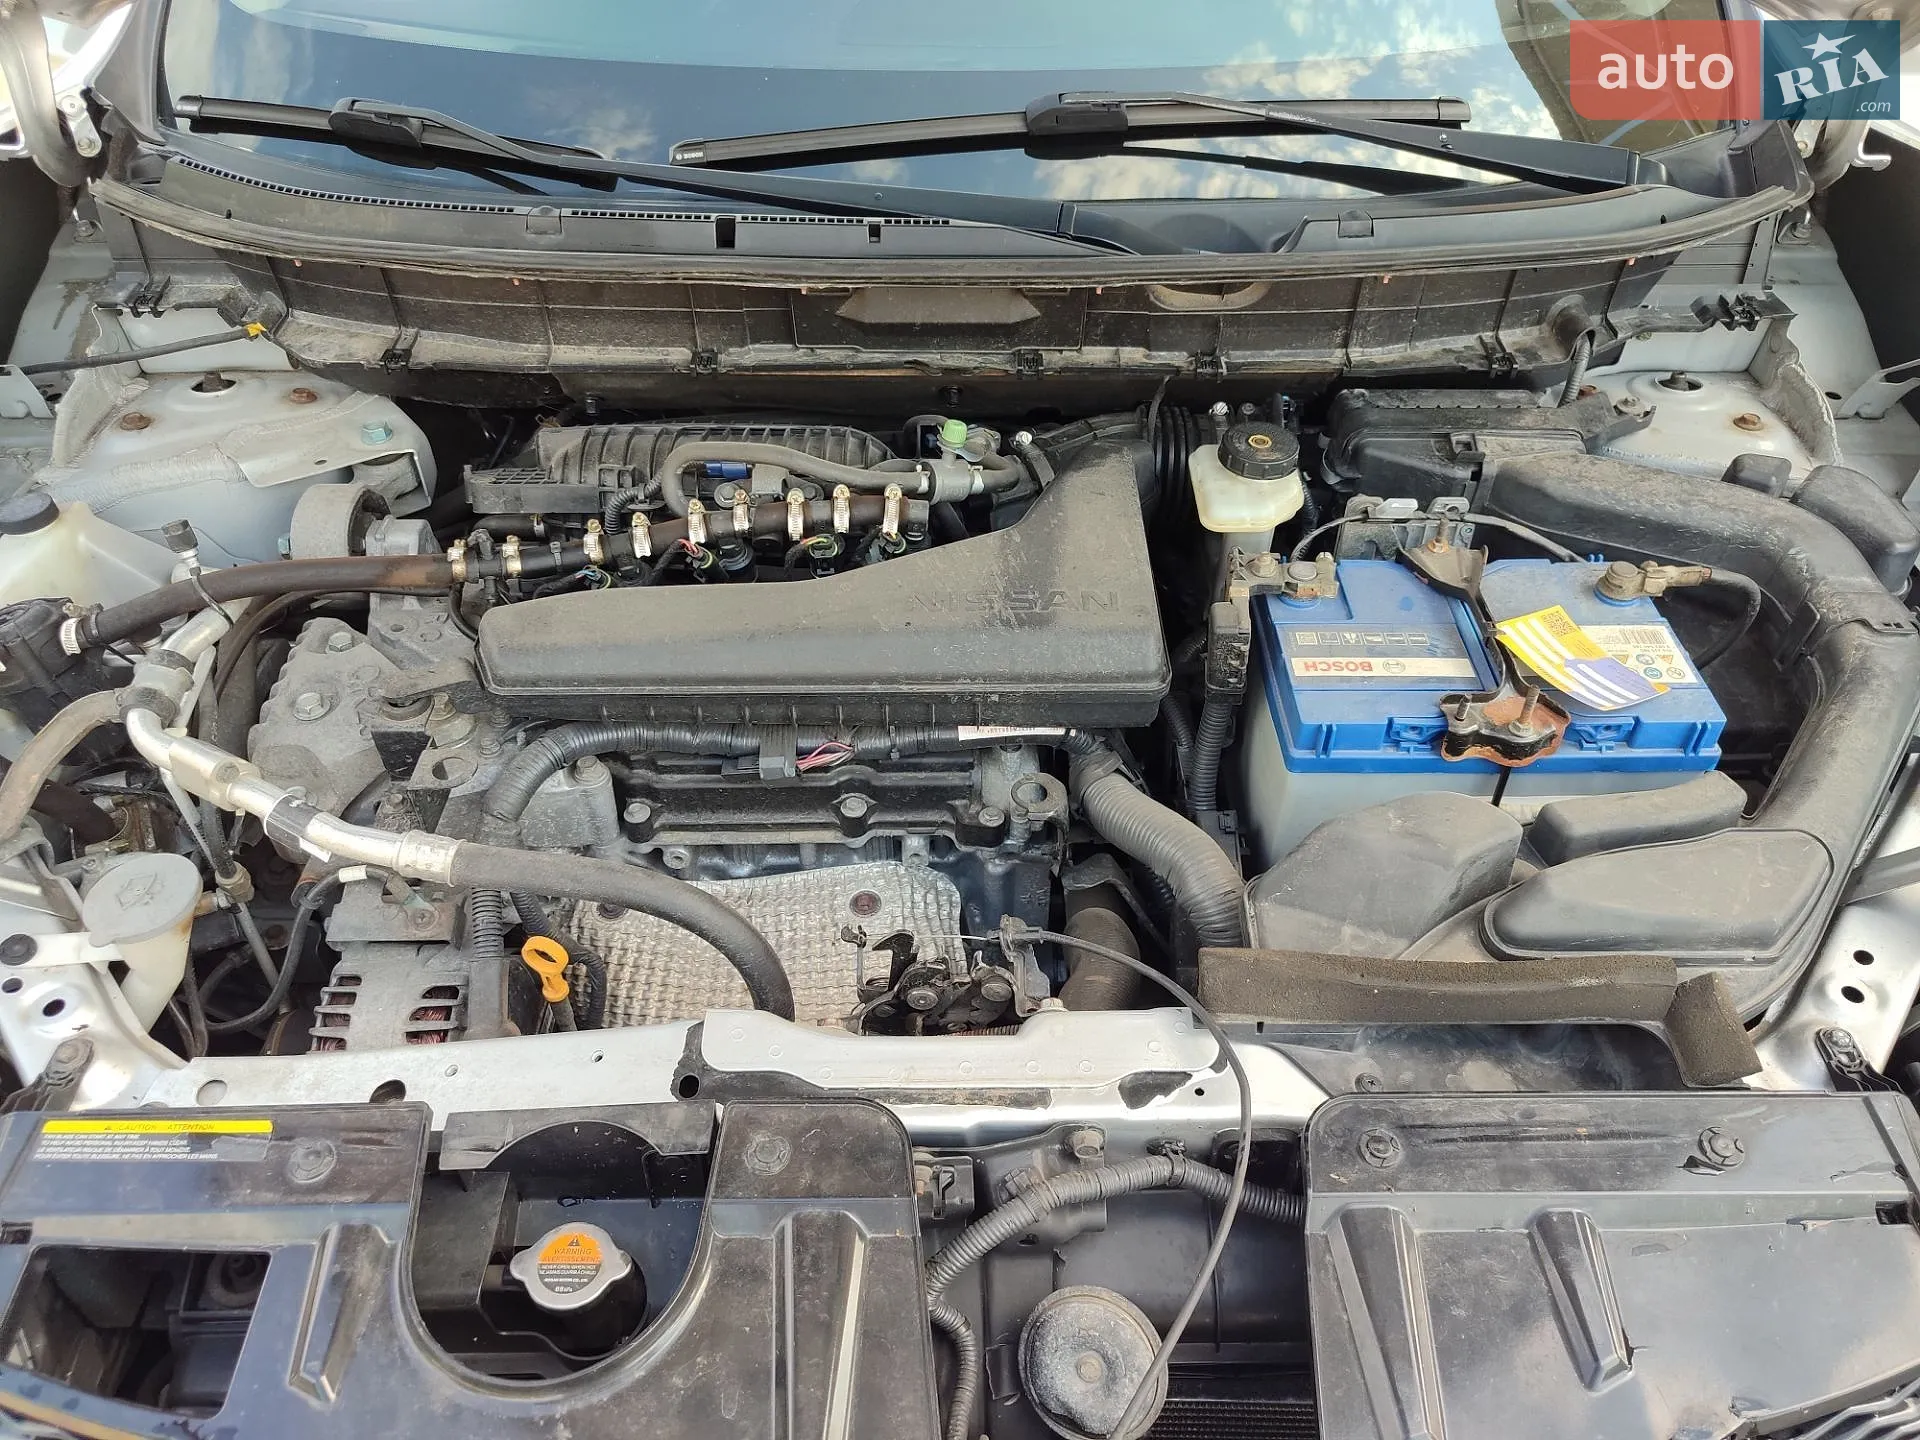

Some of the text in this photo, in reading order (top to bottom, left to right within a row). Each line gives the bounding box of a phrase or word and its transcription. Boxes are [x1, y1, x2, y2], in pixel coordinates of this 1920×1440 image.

[910, 590, 1120, 612] NISSAN
[1303, 660, 1374, 672] BOSCH
[167, 1123, 215, 1131] ATTENTION
